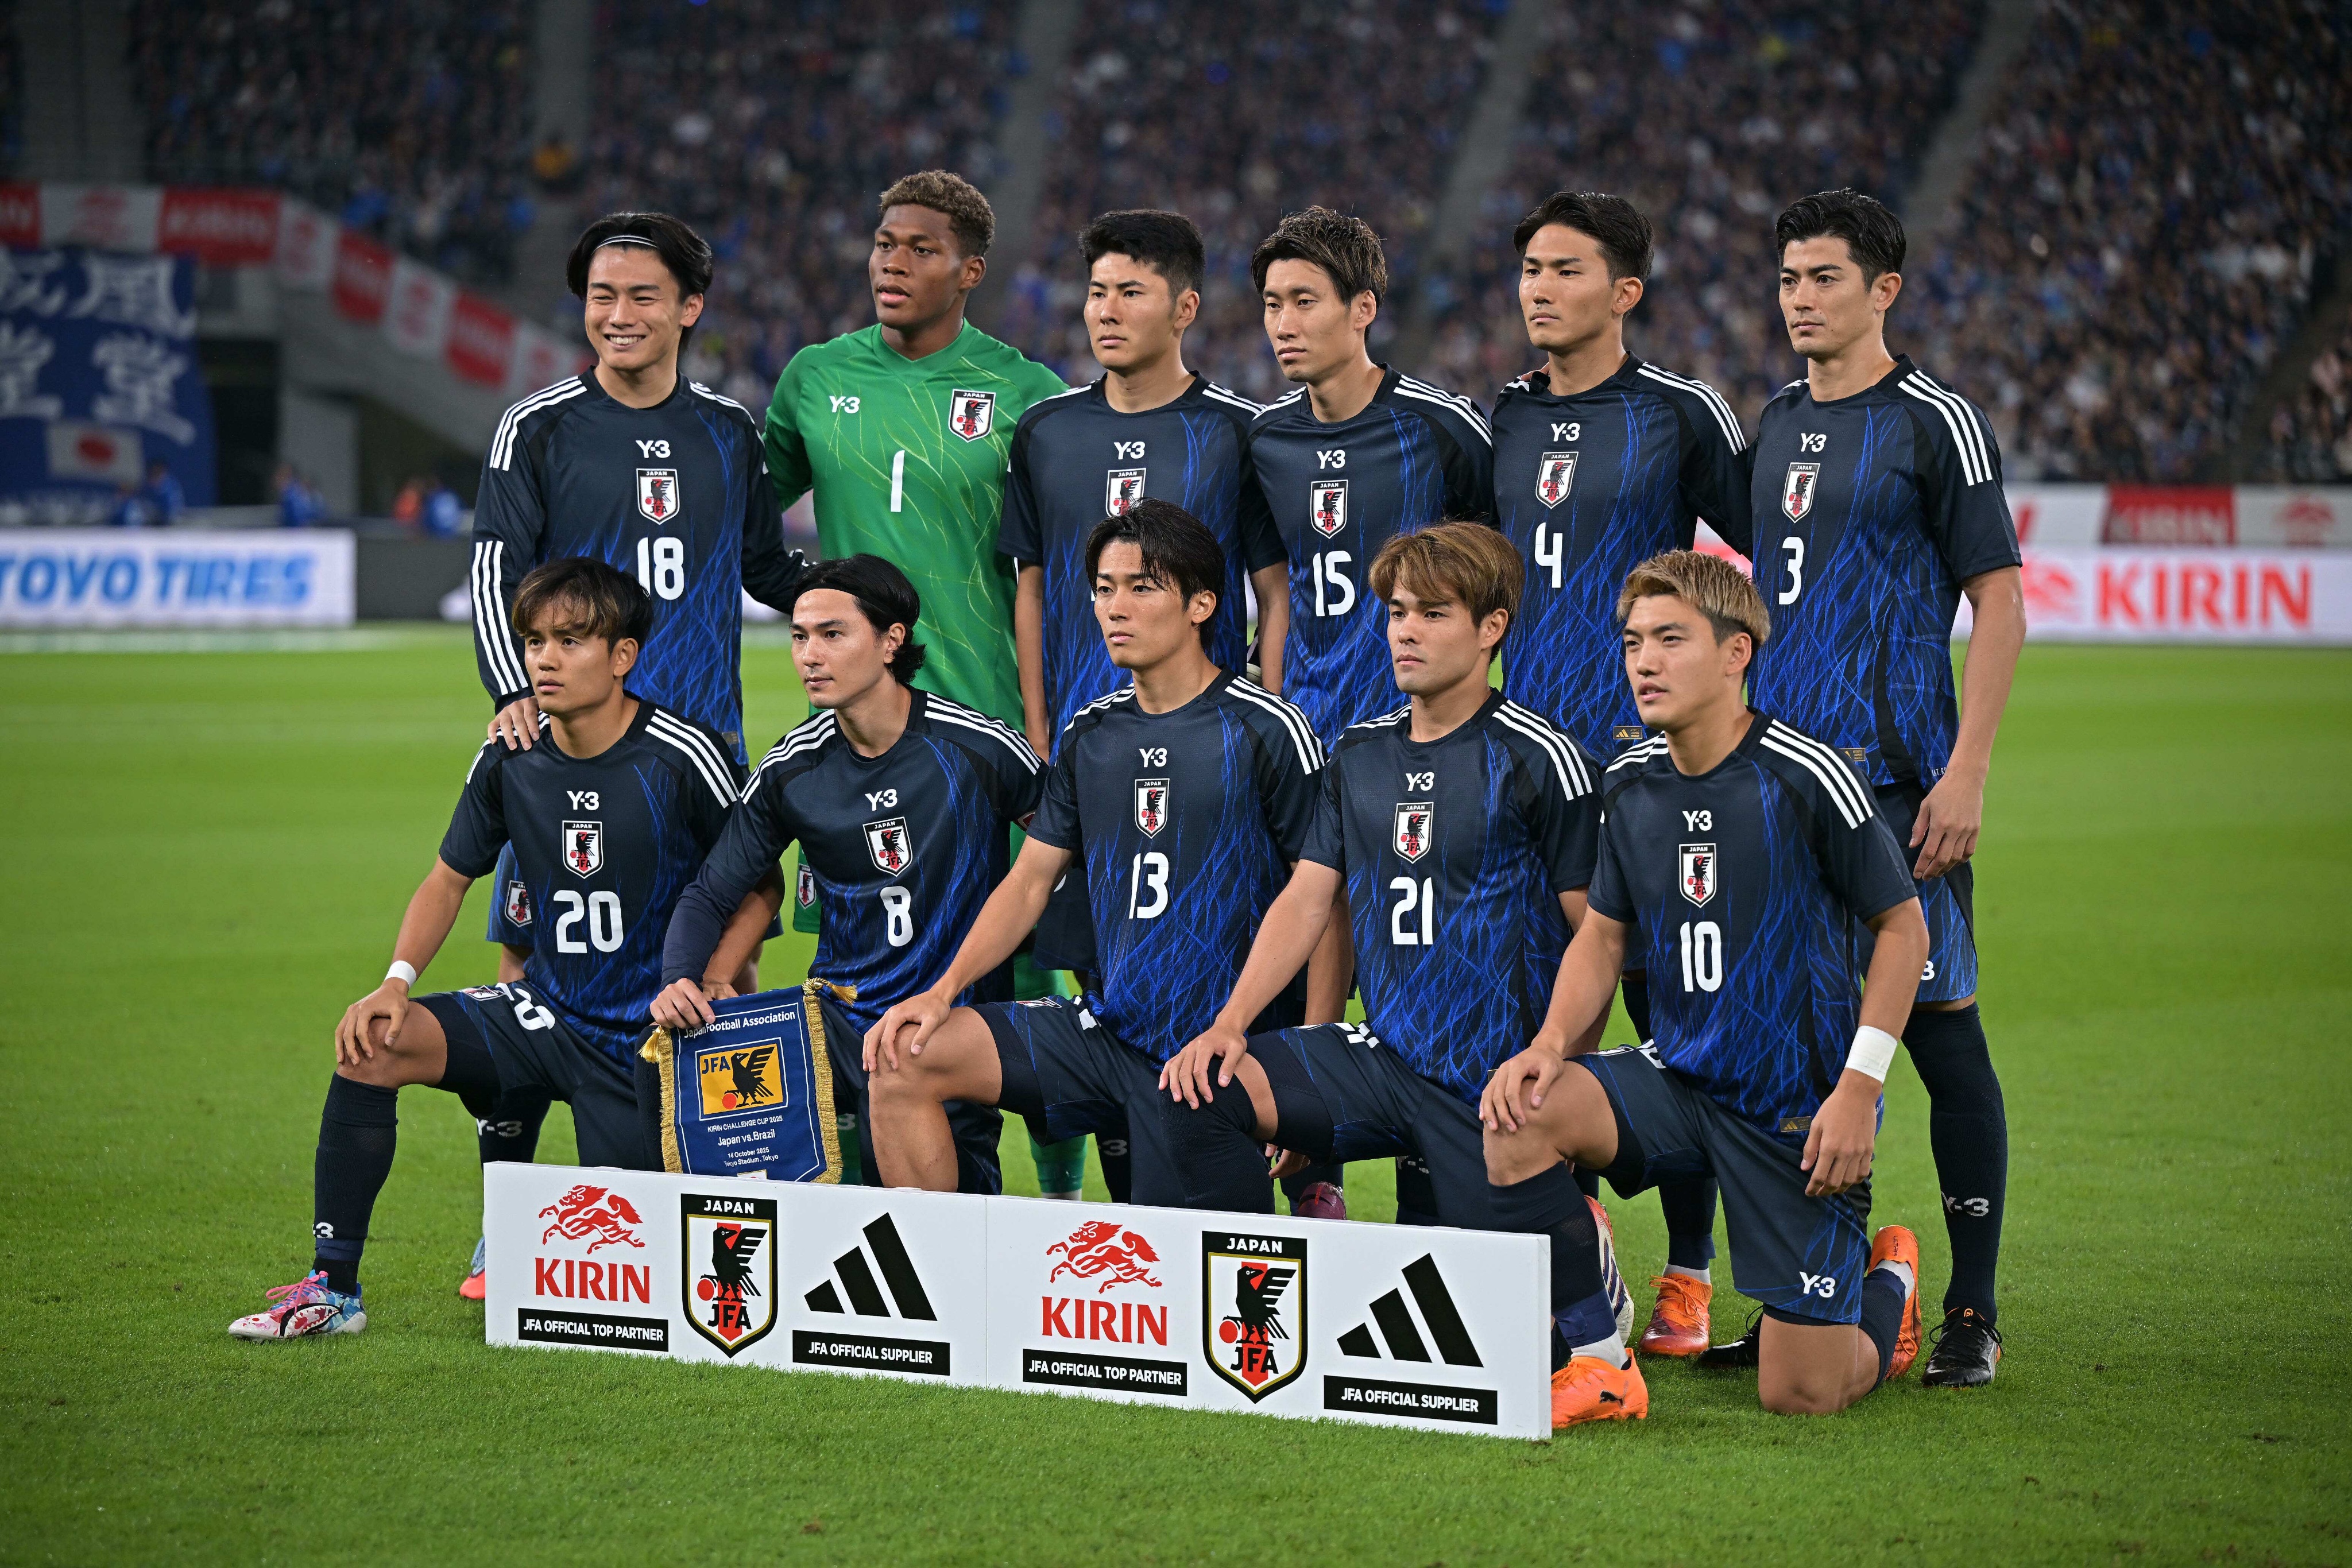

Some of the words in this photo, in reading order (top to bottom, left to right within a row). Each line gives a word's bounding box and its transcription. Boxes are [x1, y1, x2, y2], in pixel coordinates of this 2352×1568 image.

[829, 396, 860, 413] Y-3
[1551, 423, 1580, 442] Y-3
[1801, 433, 1827, 452] Y-3
[635, 440, 671, 458] Y-3
[1113, 441, 1146, 460] Y-3
[1317, 450, 1345, 469] Y-3
[891, 450, 905, 513] 1
[1535, 522, 1562, 589] 4
[637, 537, 684, 600] 18
[1779, 536, 1804, 605] 3
[149, 553, 315, 609] TIRES
[1313, 550, 1355, 617] 15
[2098, 563, 2312, 627] KIRIN
[1139, 748, 1167, 768] Y-3
[1405, 772, 1434, 791] Y-3
[567, 791, 599, 811] Y-3
[865, 789, 898, 811] Y-3
[874, 821, 896, 830] JAPAN
[1682, 810, 1712, 831] Y-3
[1129, 852, 1169, 919] 13
[554, 890, 624, 953] 20
[880, 886, 914, 947] 8
[1390, 877, 1433, 944] 21
[1680, 922, 1722, 992] 10
[742, 1011, 796, 1028] Association
[701, 1057, 730, 1074] JFA
[707, 1124, 722, 1133] KIRIN
[723, 1119, 756, 1130] CHALLENGE
[757, 1117, 769, 1125] CUP
[769, 1115, 783, 1123] 2025
[718, 1135, 741, 1148] Japan
[734, 1149, 756, 1158] October
[761, 1154, 779, 1162] Tokyo
[704, 1199, 755, 1215] JAPAN
[1227, 1237, 1283, 1254] JAPAN
[535, 1257, 651, 1304] KIRIN
[1799, 1271, 1836, 1298] Y-3
[707, 1304, 752, 1330] JFA
[1041, 1296, 1168, 1346] KIRIN
[523, 1318, 542, 1333] JFA
[544, 1320, 591, 1337] OFFICIAL
[593, 1323, 613, 1338] TOP
[615, 1325, 664, 1342] PARTNER
[808, 1341, 828, 1356] JFA
[830, 1344, 879, 1360] OFFICIAL
[880, 1348, 933, 1364] SUPPLIER
[1230, 1346, 1279, 1375] JFA
[1028, 1360, 1049, 1375] JFA
[1051, 1362, 1102, 1380] OFFICIAL
[1104, 1366, 1127, 1381] TOP
[1129, 1368, 1183, 1386] PARTNER
[1341, 1387, 1363, 1403] JFA
[1365, 1389, 1419, 1408] OFFICIAL
[1421, 1393, 1479, 1413] SUPPLIER
